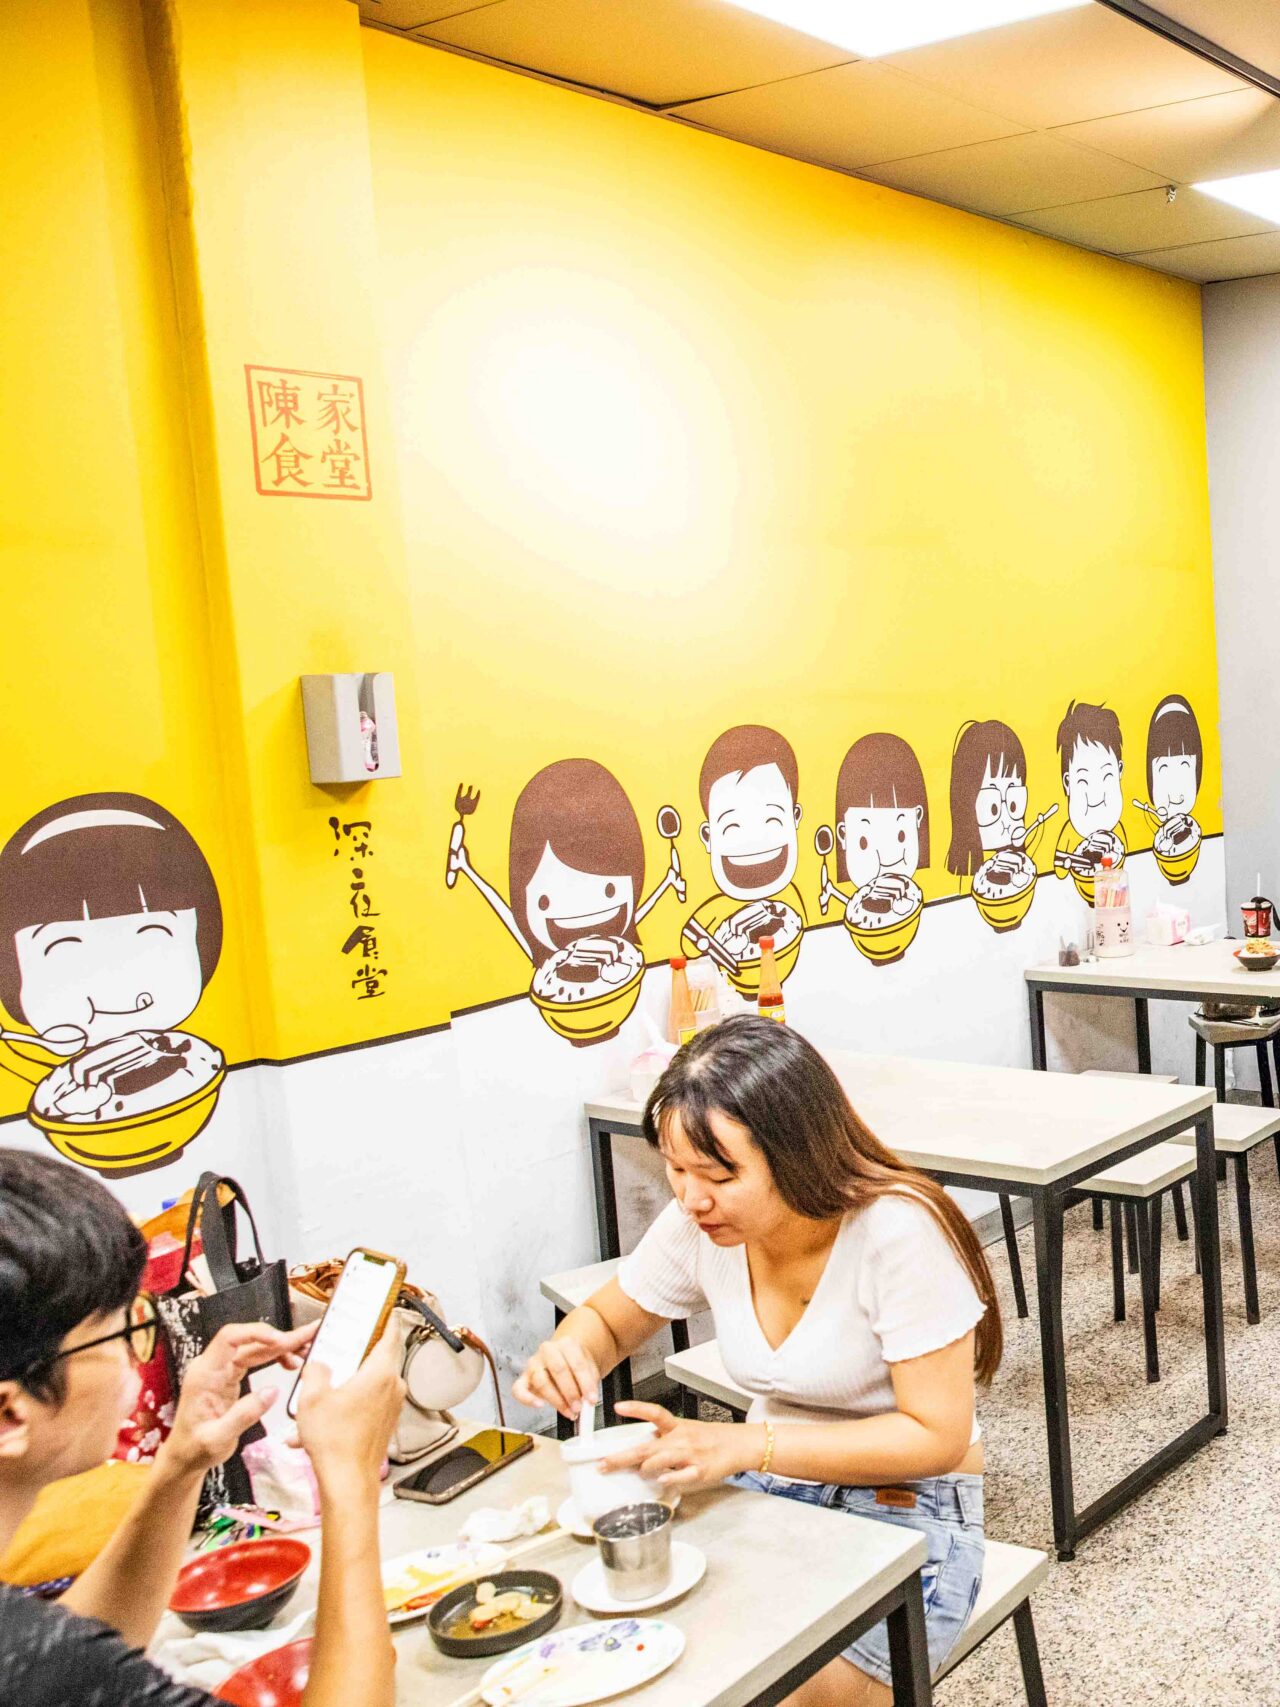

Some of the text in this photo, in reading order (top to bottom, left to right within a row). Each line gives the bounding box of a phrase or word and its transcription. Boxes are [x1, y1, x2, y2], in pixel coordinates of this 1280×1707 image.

[256, 379, 360, 434] 陳家
[260, 432, 361, 490] 食堂
[328, 815, 388, 1000] 深夜食堂
